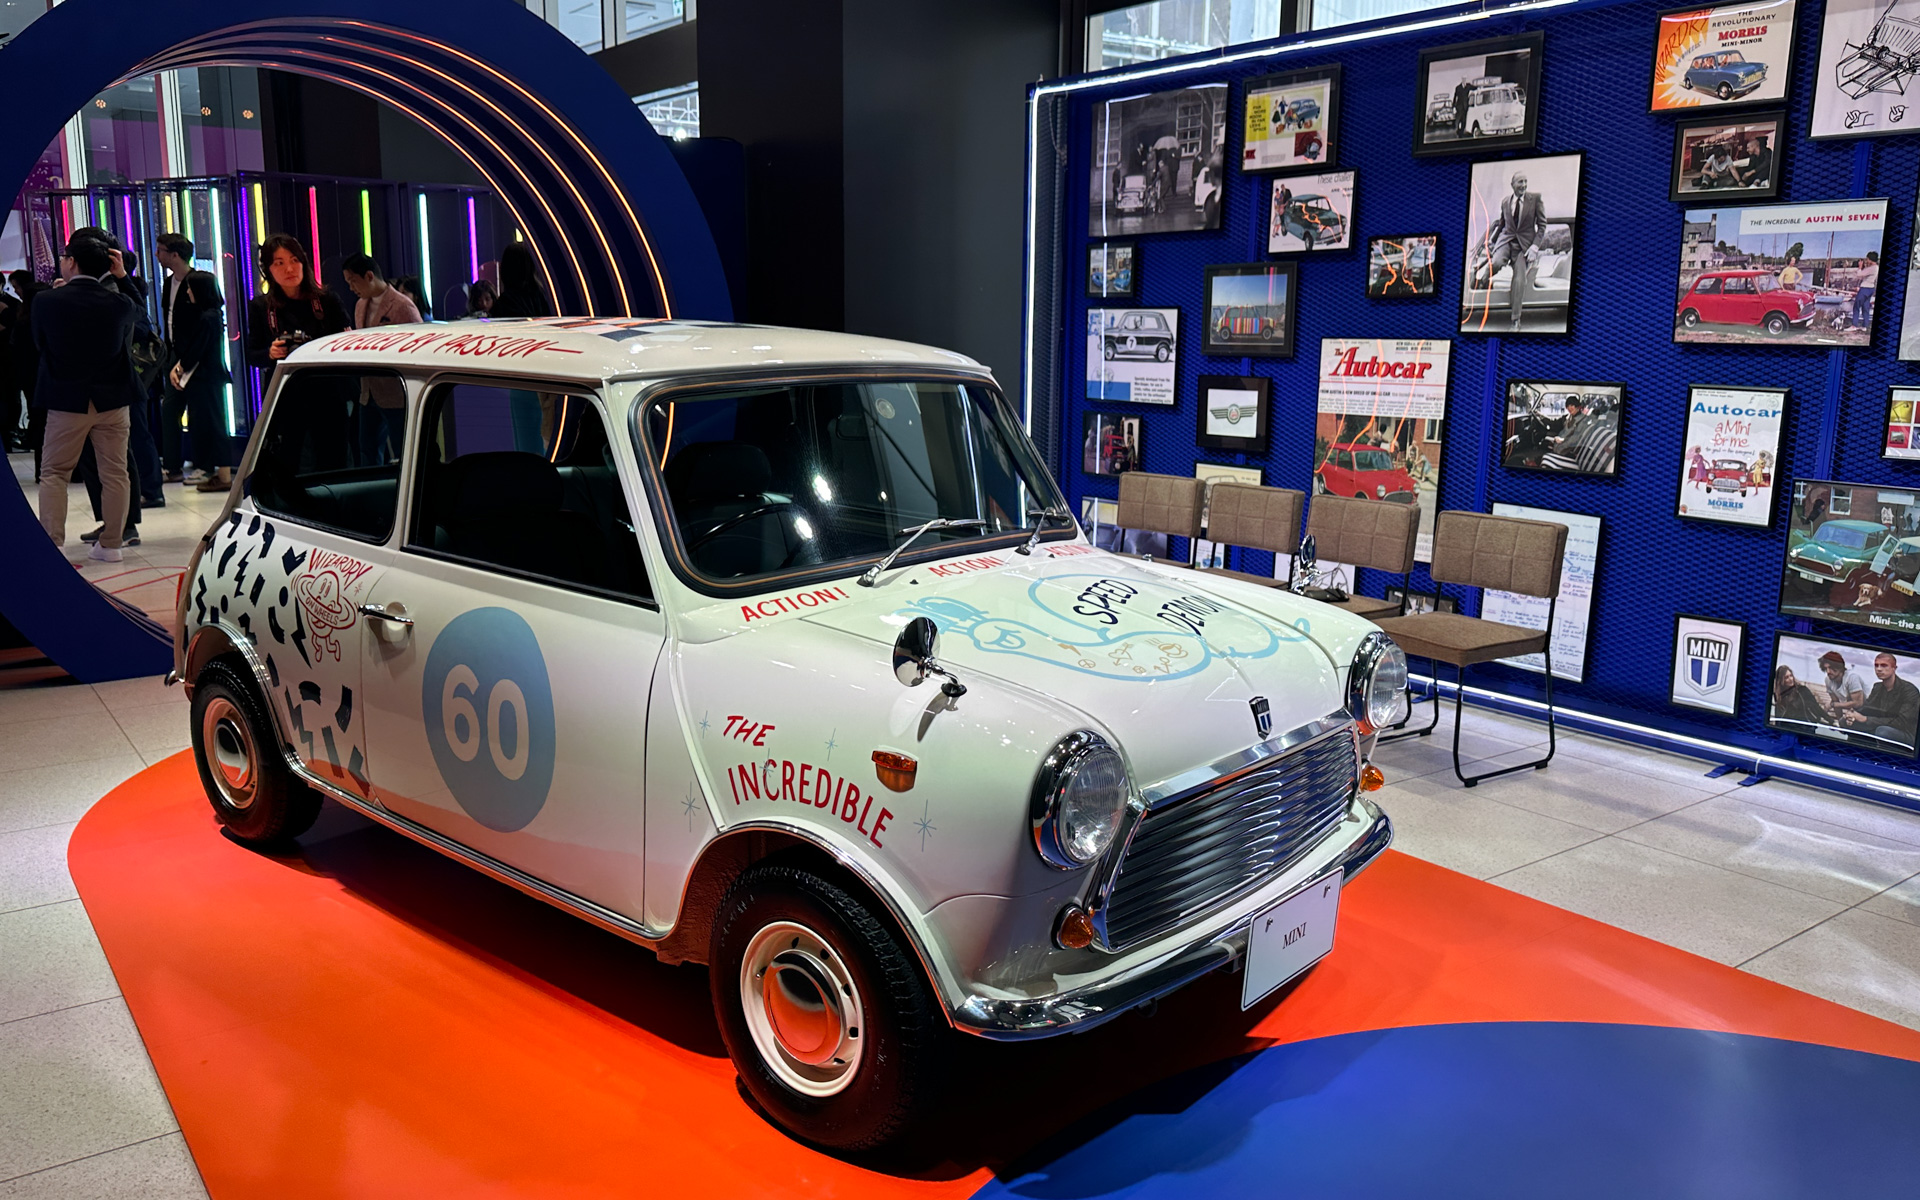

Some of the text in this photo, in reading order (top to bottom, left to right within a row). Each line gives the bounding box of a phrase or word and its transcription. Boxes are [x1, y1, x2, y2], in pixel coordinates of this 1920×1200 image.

[1712, 13, 1776, 28] REVOLUTIONARY
[1718, 25, 1768, 41] MORRIS
[1765, 218, 1801, 226] INCREDIBLE
[1805, 215, 1843, 224] AUSTIN
[1848, 213, 1880, 222] SEVEN
[398, 332, 453, 354] BY
[1129, 339, 1134, 348] 7
[1334, 348, 1344, 356] The
[1328, 346, 1432, 379] Autocar
[1692, 402, 1782, 418] Autocar
[1714, 420, 1752, 436] a Mini
[1711, 433, 1750, 448] for me
[1707, 498, 1744, 510] MORRIS
[308, 547, 374, 592] WIZARDRY
[927, 556, 1010, 578] ACTION!
[305, 596, 340, 626] ON WHEELS
[740, 586, 850, 622] ACTION!
[1072, 579, 1139, 625] SPEED
[1156, 594, 1231, 637] DEMON
[1689, 639, 1726, 660] MINI
[441, 663, 531, 781] 60
[722, 715, 776, 747] THE
[727, 758, 894, 849] INCREDIBLE
[1282, 921, 1307, 950] MINI
